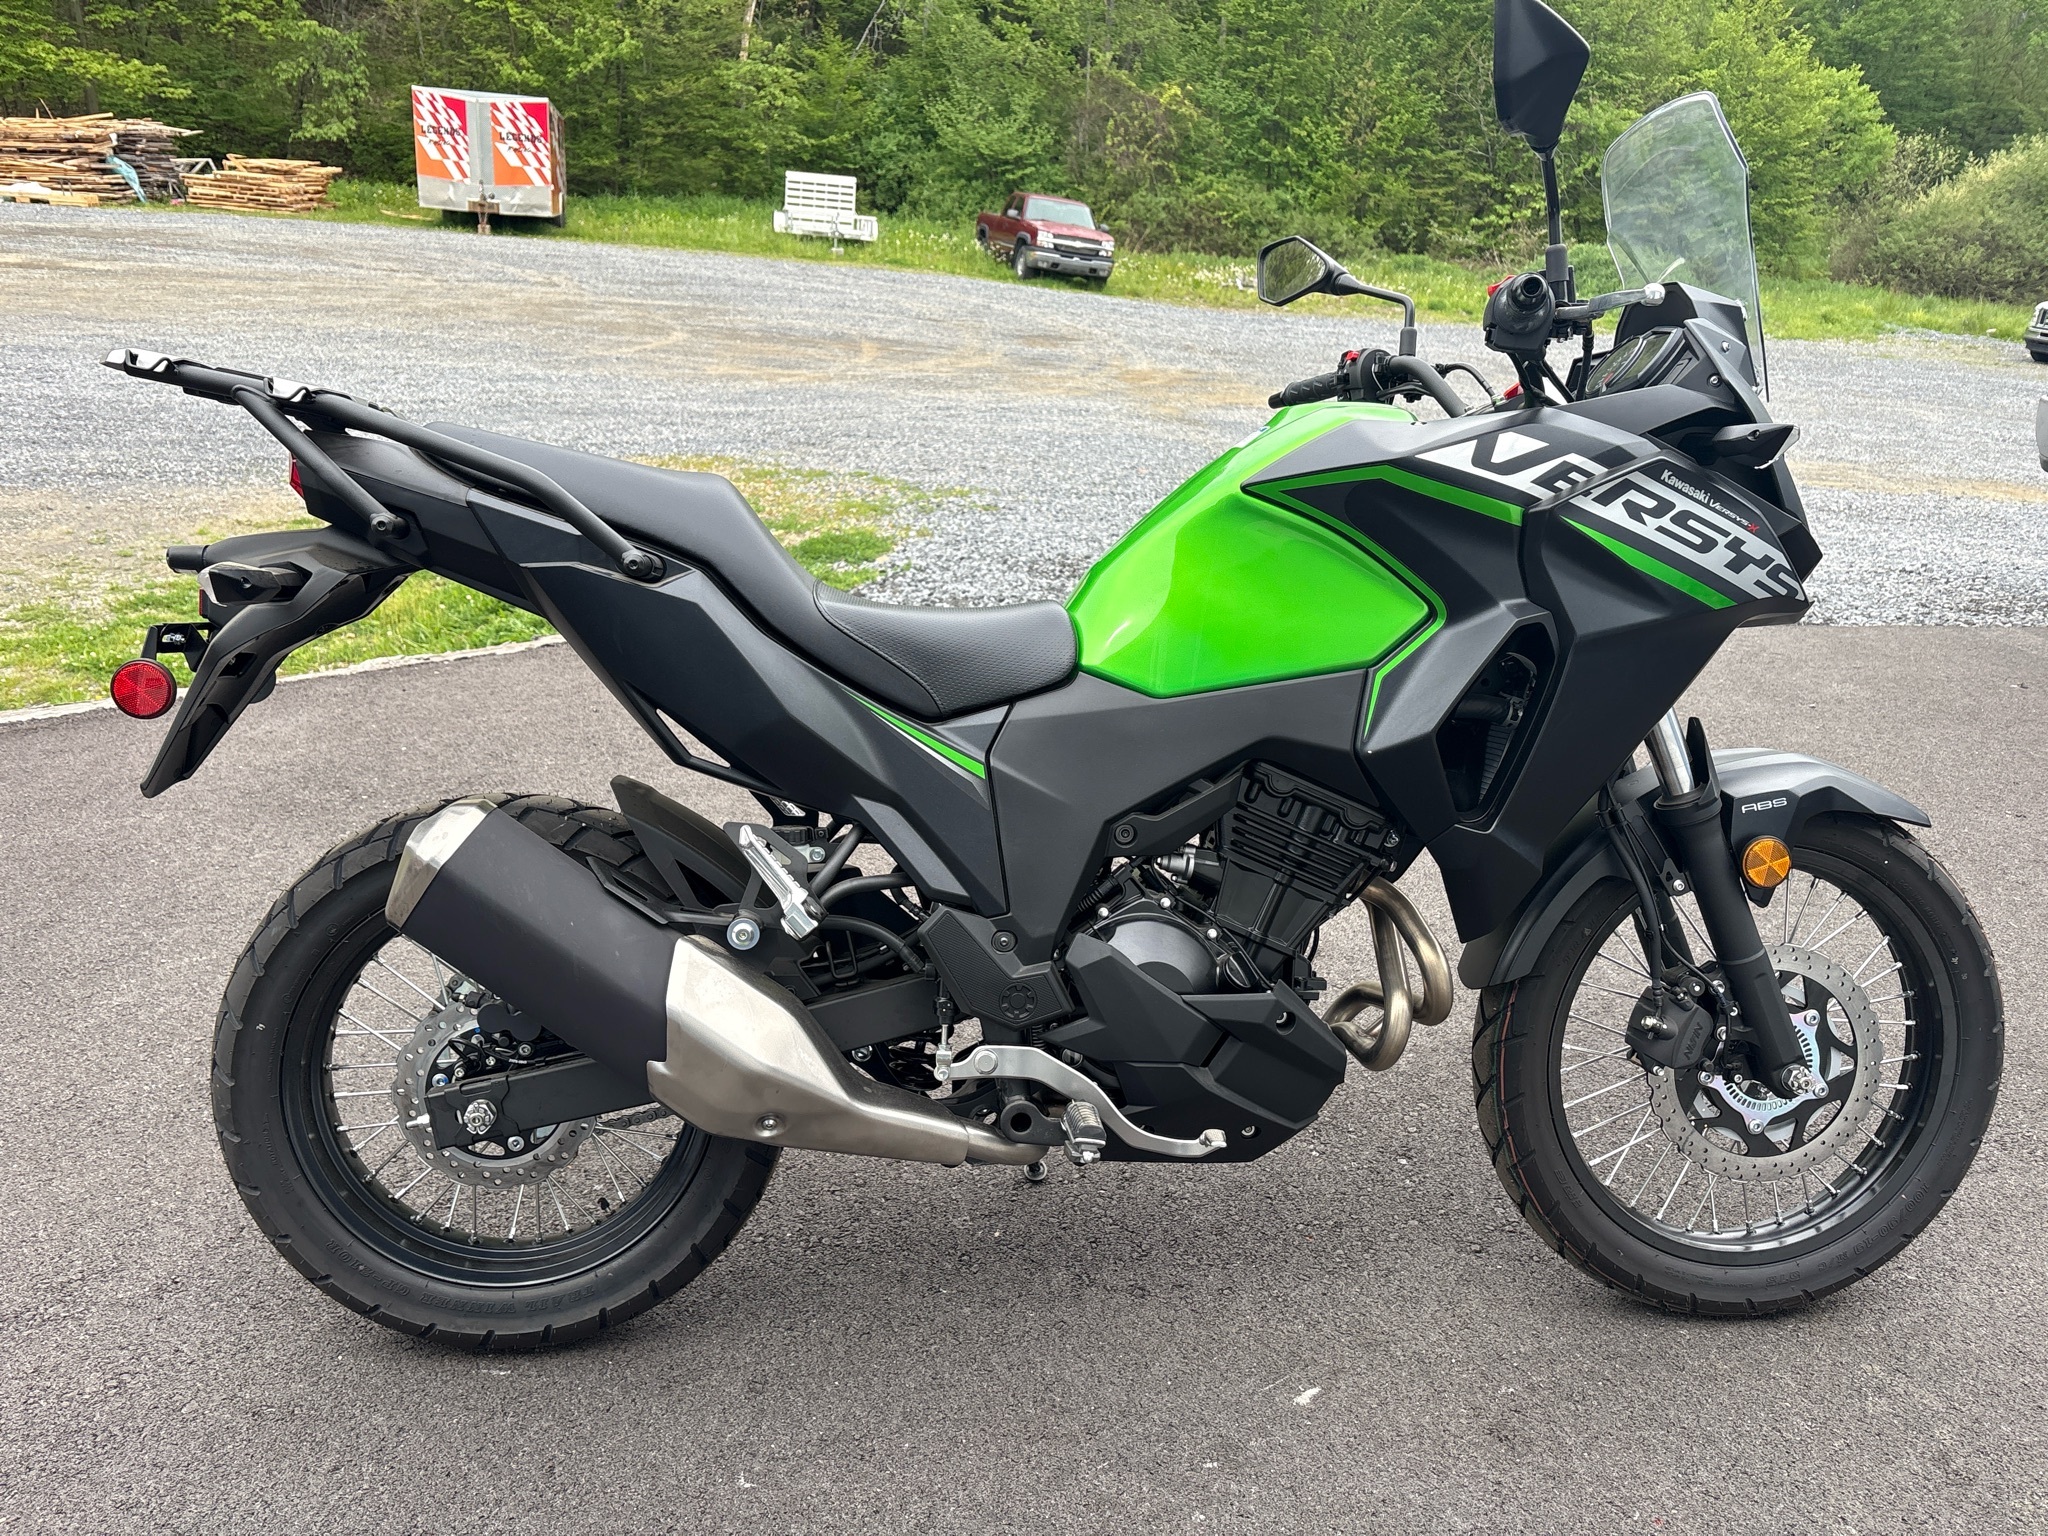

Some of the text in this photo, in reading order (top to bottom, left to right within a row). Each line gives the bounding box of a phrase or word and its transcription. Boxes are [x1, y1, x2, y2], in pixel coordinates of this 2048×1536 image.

[1471, 431, 1806, 601] VERSYS
[1660, 468, 1760, 534] Kawasaki VERSYS-X
[1741, 797, 1788, 814] ABS
[1852, 1181, 1931, 1256] 100/90-19
[418, 1292, 517, 1314] WINNER
[525, 1284, 596, 1312] TRAIL
